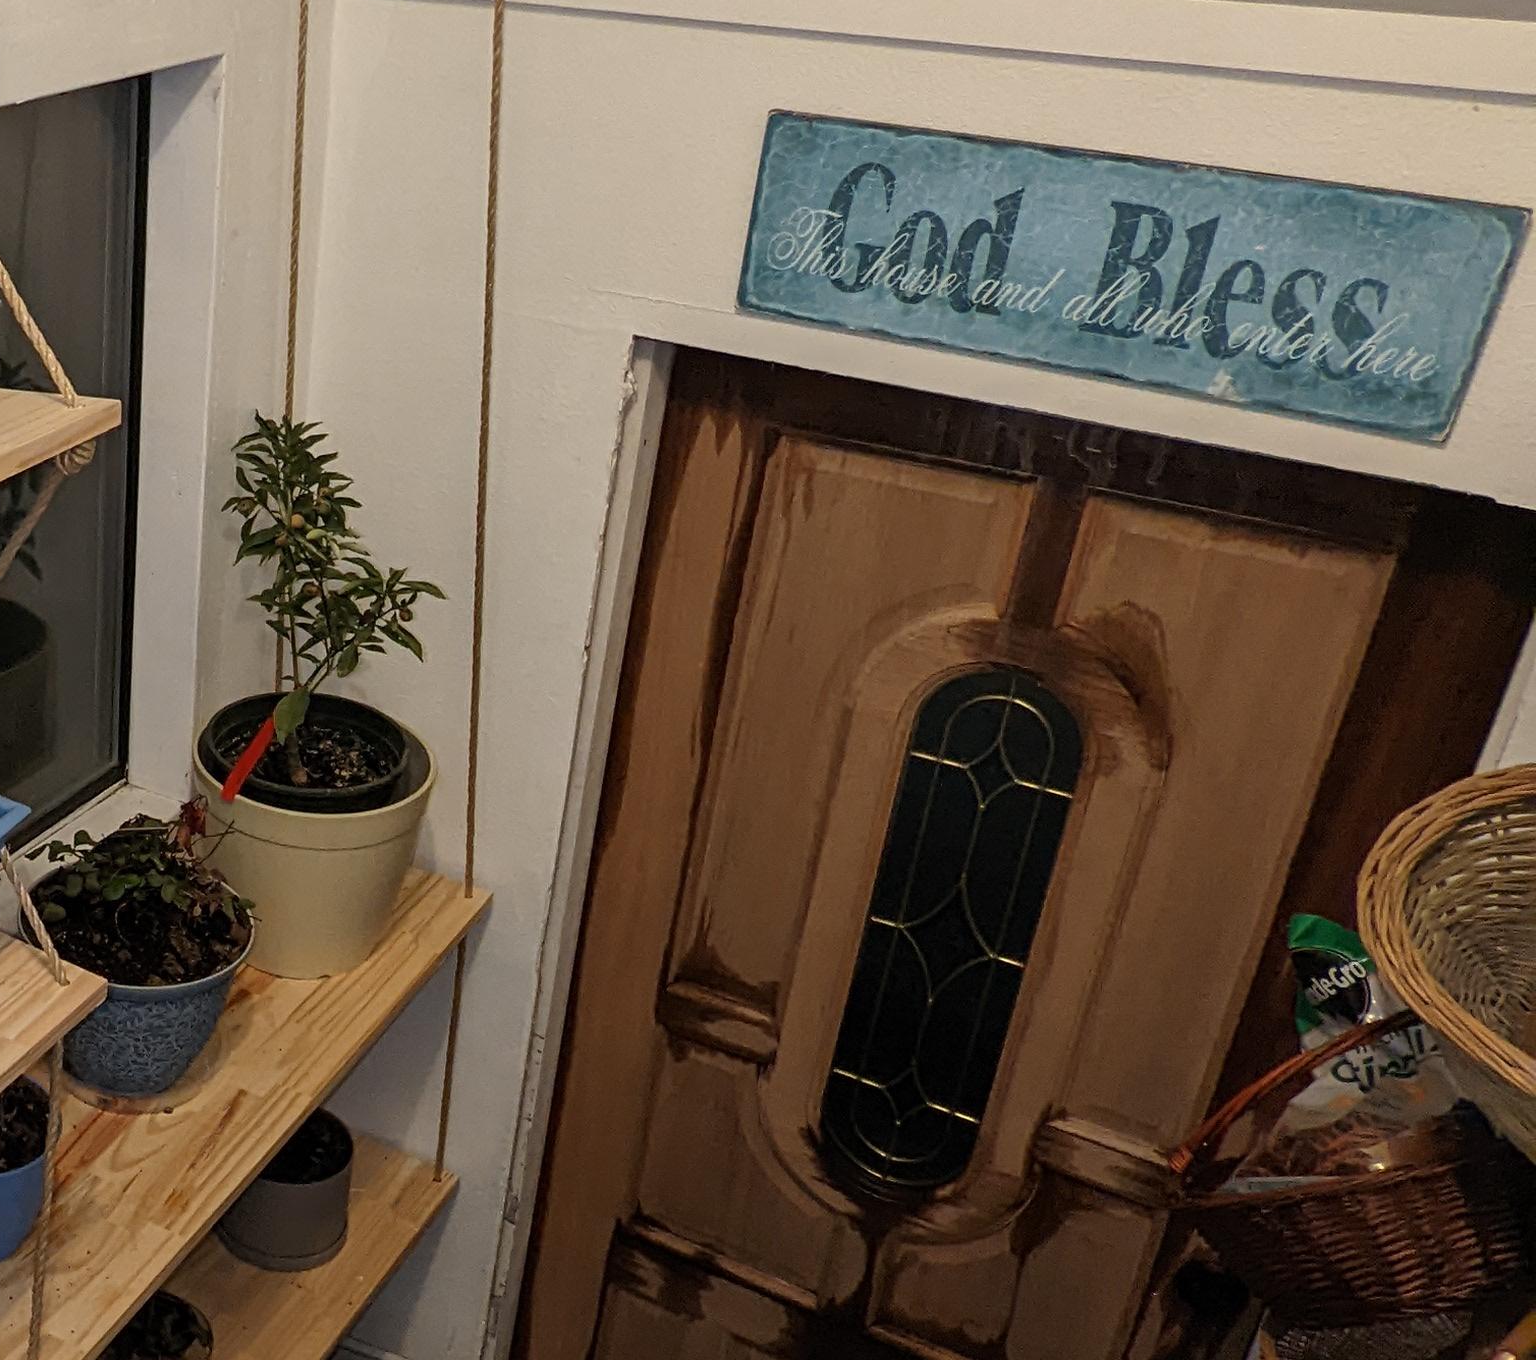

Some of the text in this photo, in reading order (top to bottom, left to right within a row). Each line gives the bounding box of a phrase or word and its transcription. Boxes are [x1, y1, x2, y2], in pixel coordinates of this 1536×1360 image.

[768, 207, 1441, 384] This house and all who enter here
[823, 161, 1391, 382] God Bless
